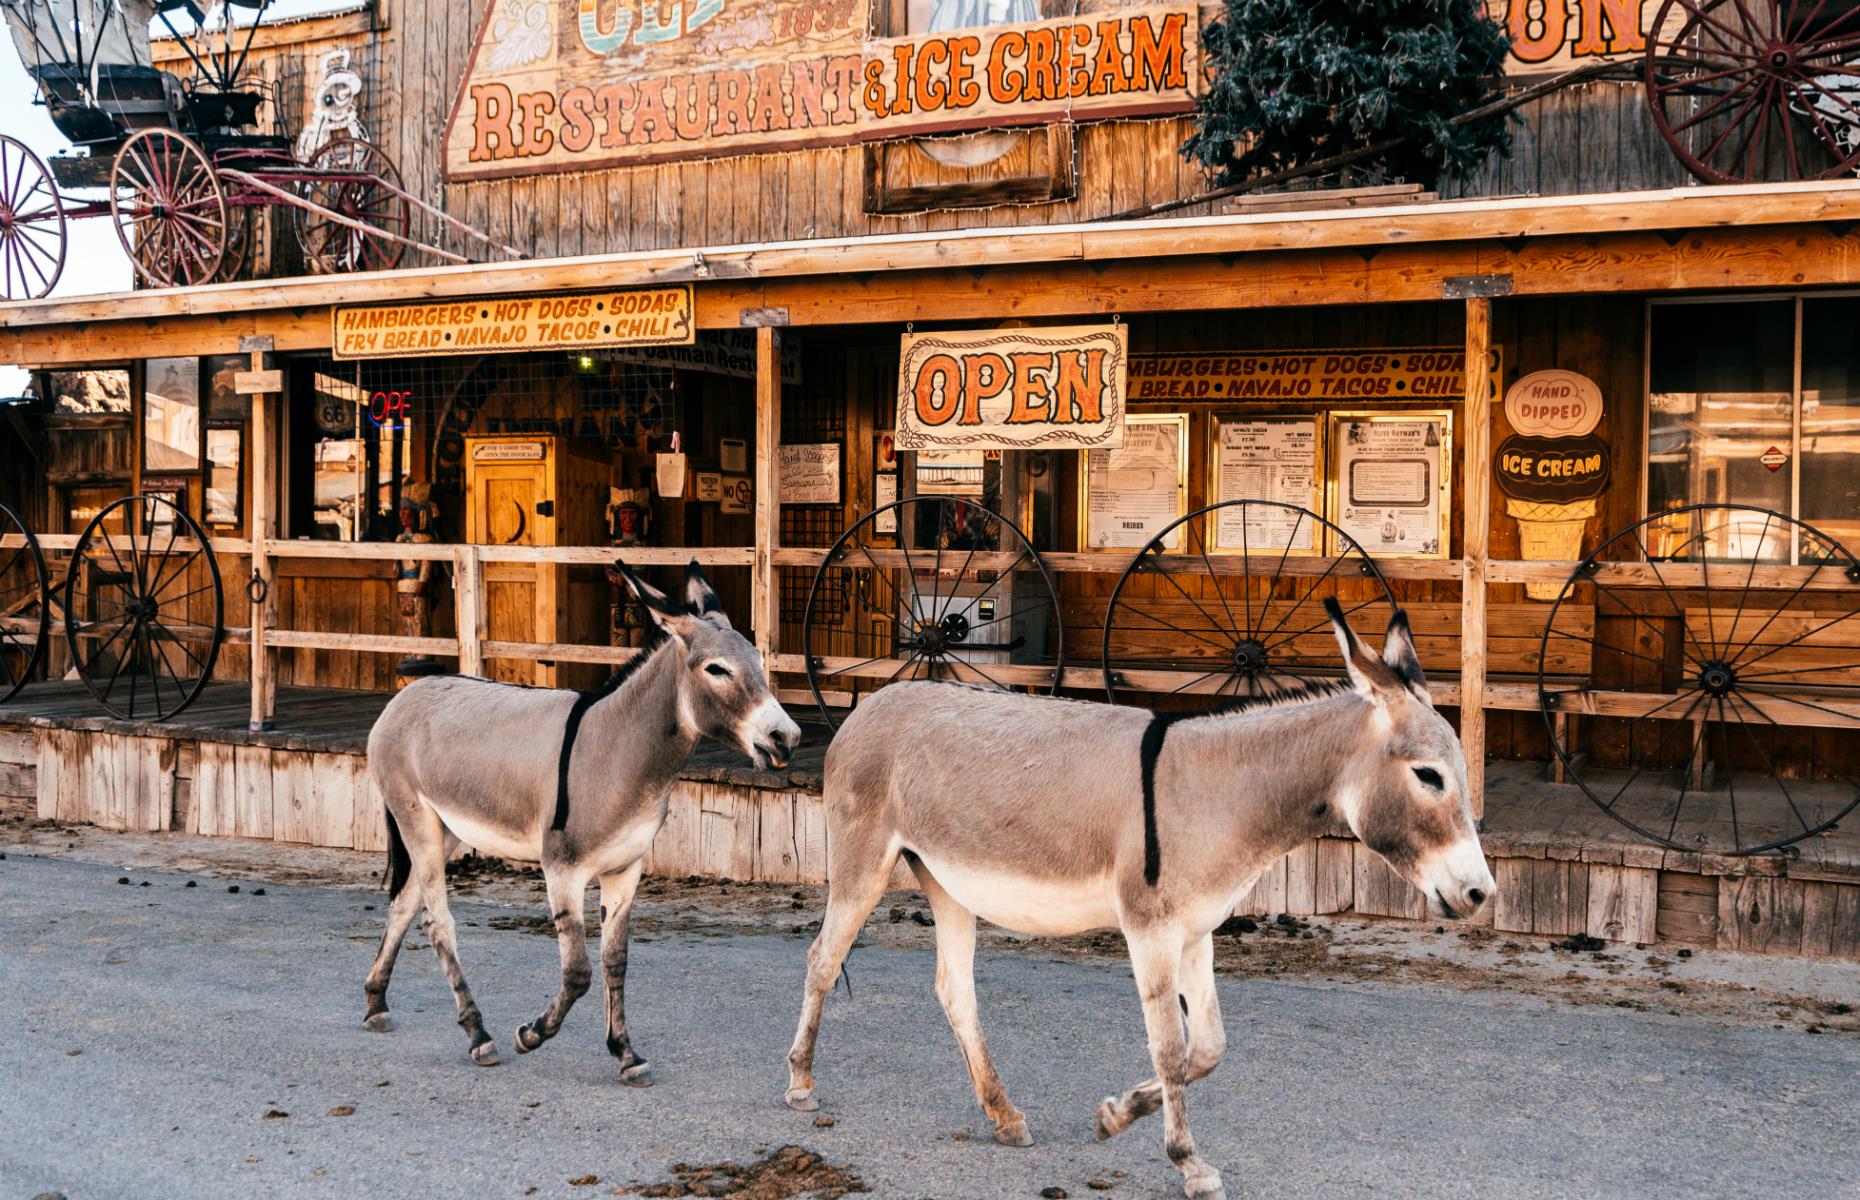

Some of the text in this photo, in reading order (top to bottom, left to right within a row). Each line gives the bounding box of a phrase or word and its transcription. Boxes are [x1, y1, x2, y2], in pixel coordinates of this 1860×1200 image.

[864, 13, 1188, 118] & ICE CREAM
[468, 54, 862, 162] RESTAURANT
[343, 293, 678, 330] HAMBURGERS HOT DOGS SODAS
[343, 317, 669, 351] FRY BREAD NAVAJO TACOS CHILI
[1127, 354, 1465, 377] MBURGERS HOT DOGS SODA
[912, 348, 1108, 426] OPEN
[1139, 380, 1210, 397] BREAD
[1227, 379, 1312, 397] NAVAJO
[1320, 378, 1391, 395] TACOS
[1411, 376, 1466, 394] CHIL
[1532, 386, 1571, 399] HAND
[1521, 404, 1581, 419] DIPPED
[1503, 454, 1601, 477] ICE CREAM
[723, 485, 734, 498] NO
